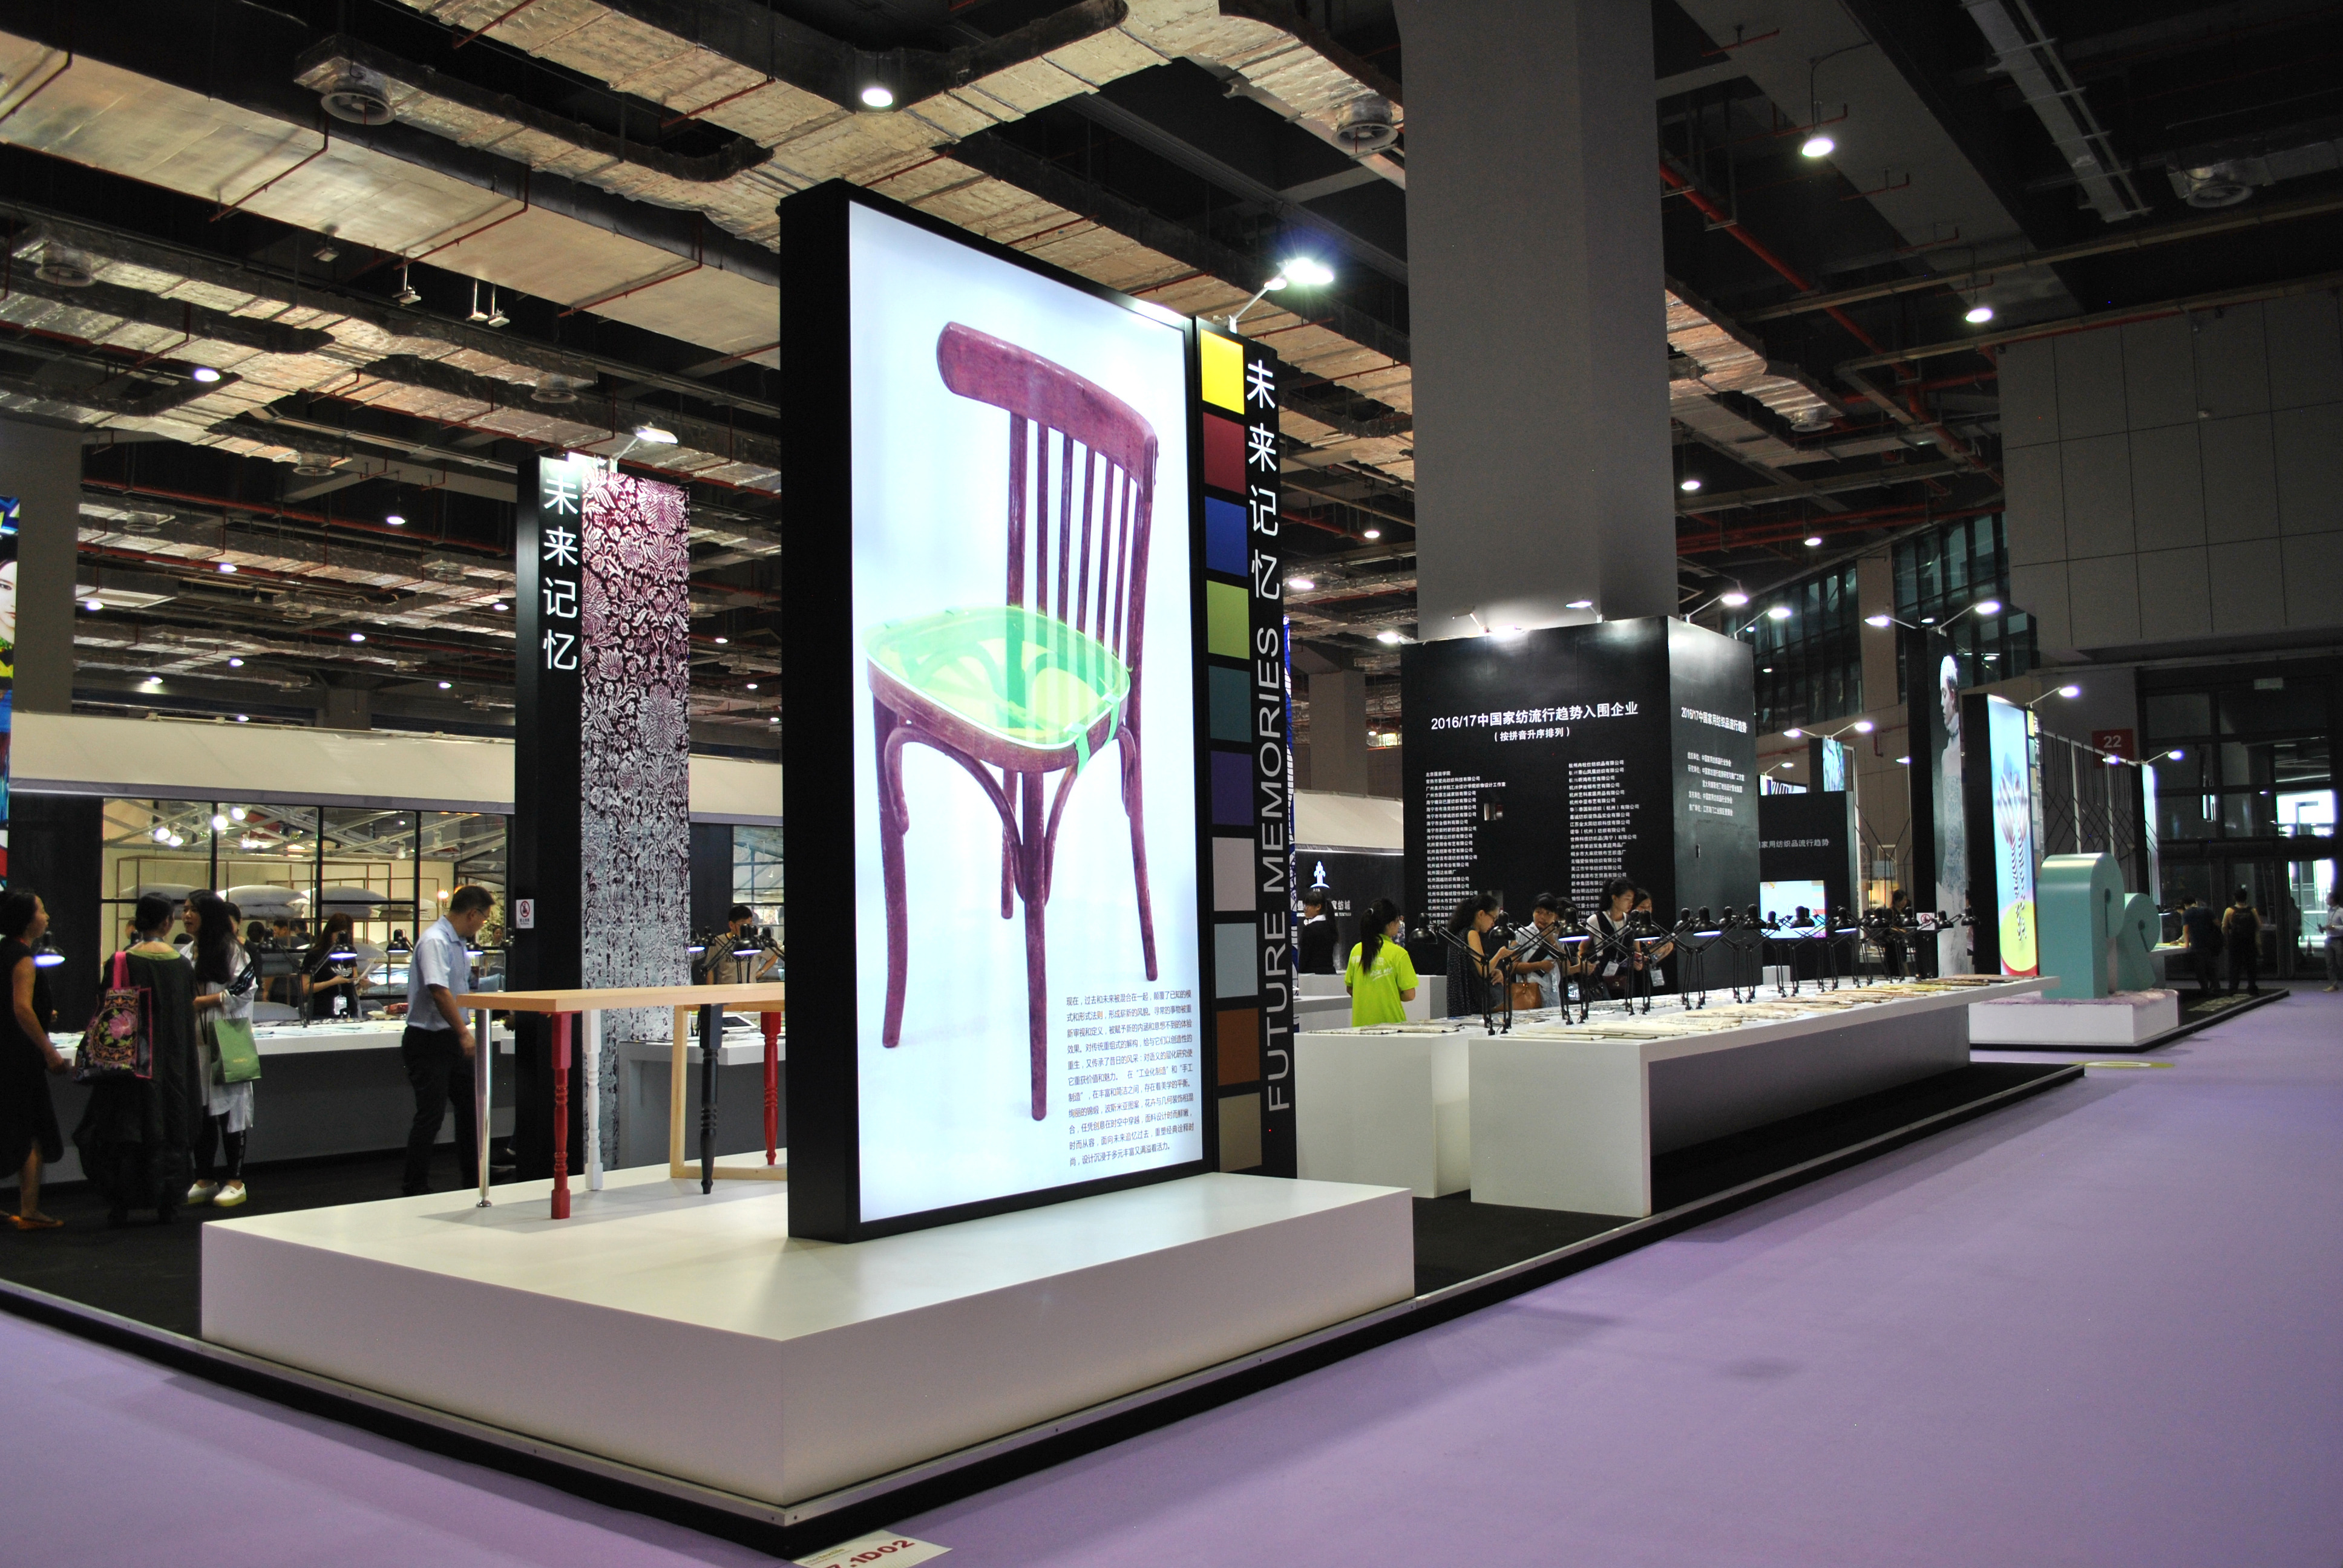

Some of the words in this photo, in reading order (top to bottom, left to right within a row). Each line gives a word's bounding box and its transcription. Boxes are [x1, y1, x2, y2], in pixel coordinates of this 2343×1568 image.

[543, 475, 578, 671] 未来记忆
[1247, 359, 1280, 600] 未来记忆
[1256, 626, 1285, 894] MEMORIES
[1430, 701, 1639, 730] 2016/17中国家纺流行趋势入围企业
[2103, 735, 2122, 748] 22
[1758, 838, 1830, 848] 家用纺织品流行趋势
[1263, 909, 1290, 1113] FUTURE
